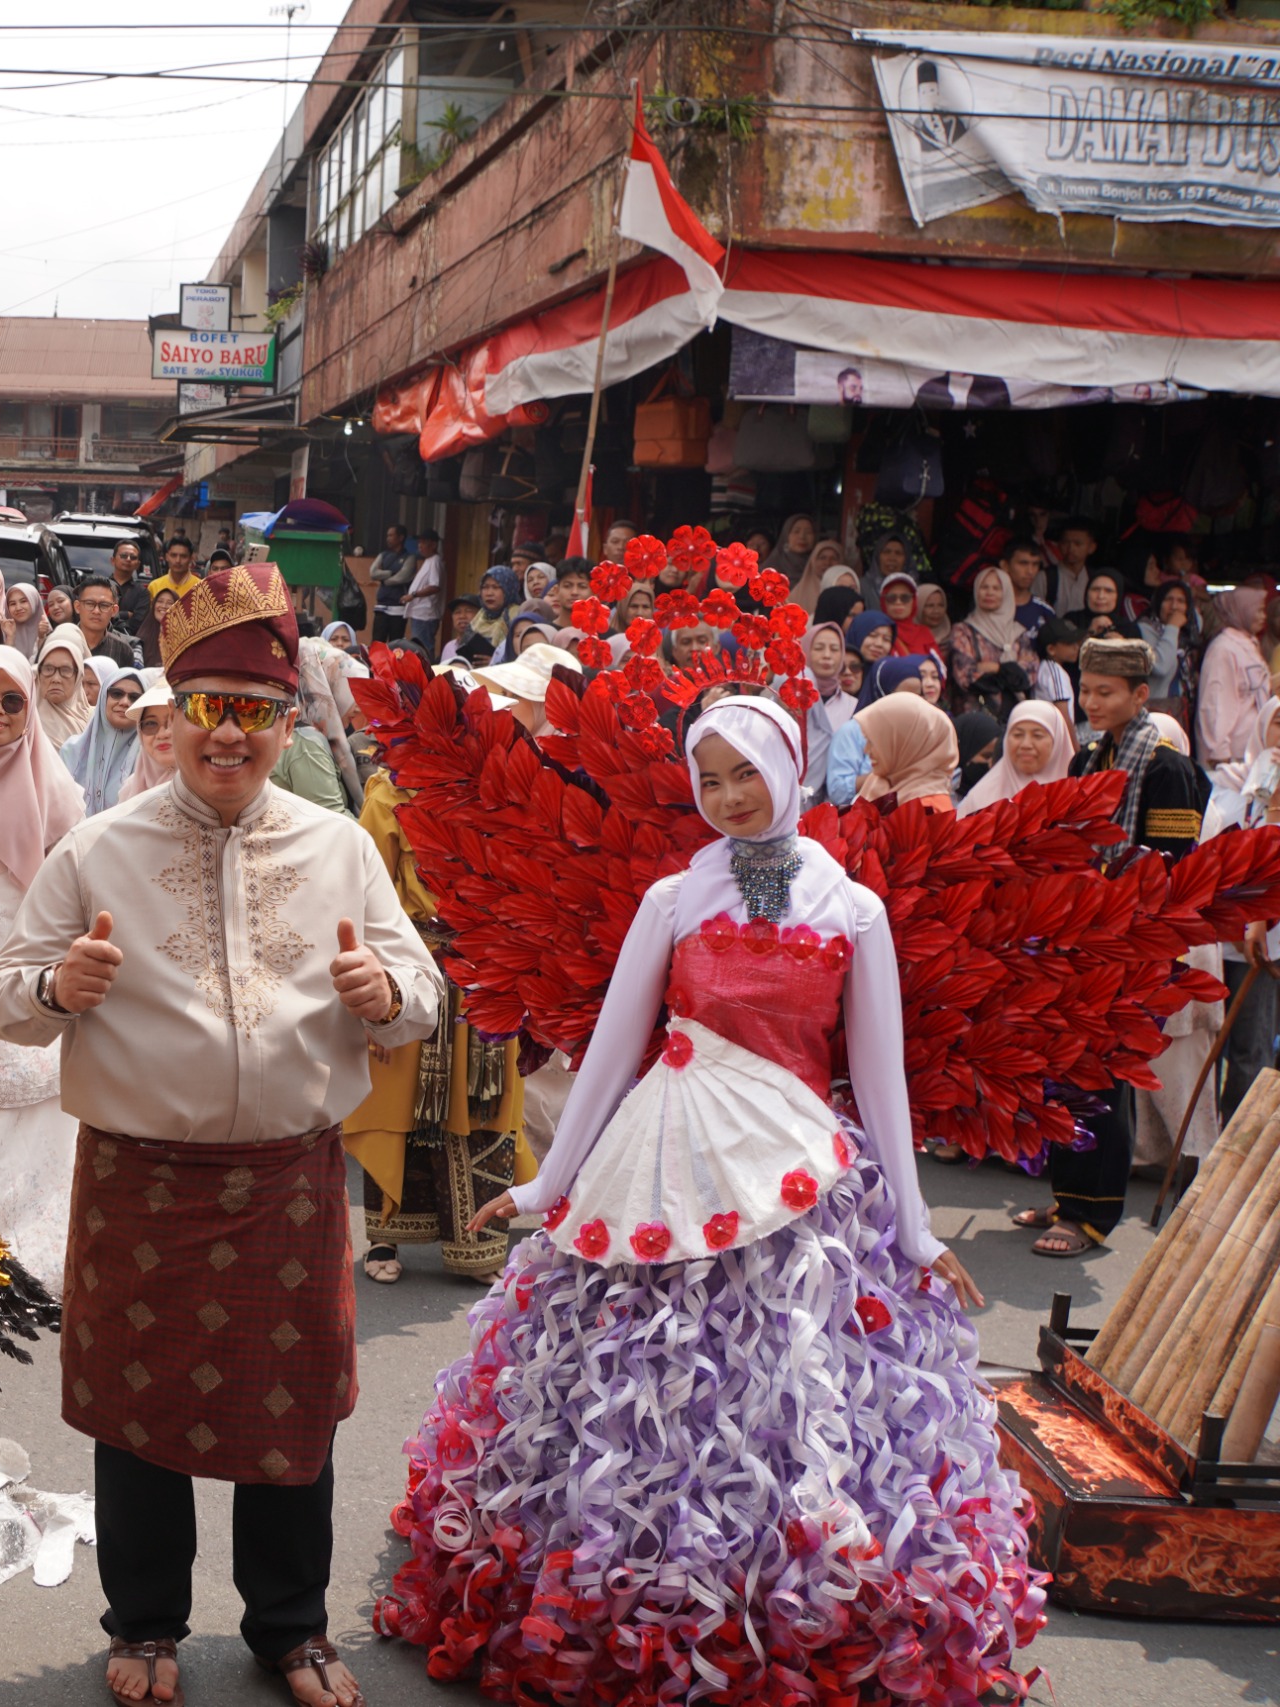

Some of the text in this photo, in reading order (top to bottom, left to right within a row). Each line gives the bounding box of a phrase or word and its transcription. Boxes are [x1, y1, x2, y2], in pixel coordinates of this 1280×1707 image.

[1033, 47, 1280, 79] Peci Nasional "A
[1046, 85, 1193, 166] DAMAI
[1061, 183, 1098, 196] Imam
[1101, 184, 1143, 202] Bonjol
[1147, 187, 1173, 200] No.
[1177, 186, 1206, 200] 157
[1207, 186, 1251, 210] Padang
[190, 333, 239, 343] BOFET
[161, 341, 269, 365] SAIYO BARU
[163, 366, 188, 375] SATE
[219, 367, 264, 378] SYUKUR
